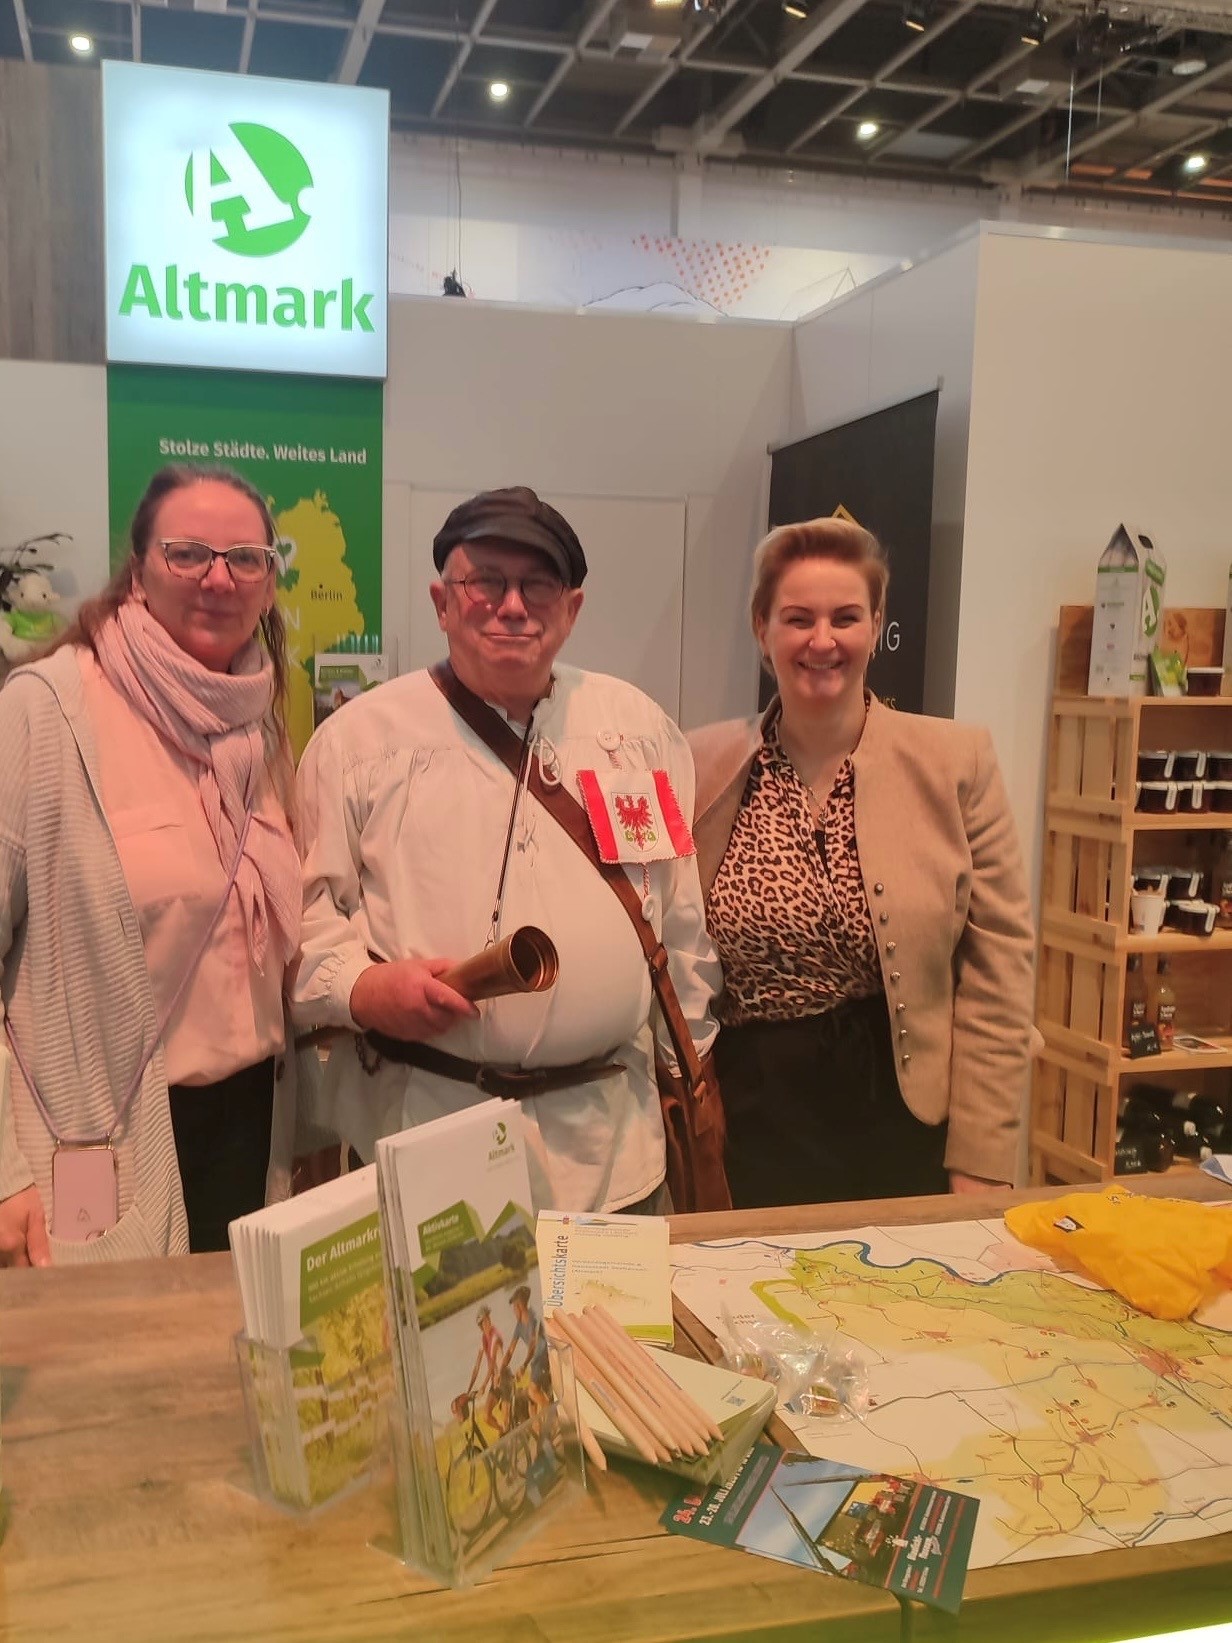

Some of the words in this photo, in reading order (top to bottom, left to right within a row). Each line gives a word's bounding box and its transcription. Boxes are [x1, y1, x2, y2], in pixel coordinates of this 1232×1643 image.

[118, 263, 376, 333] Altmark
[159, 438, 210, 457] Stolze
[213, 440, 270, 460] Städte.
[274, 444, 326, 463] Weites
[330, 448, 367, 465] Land
[311, 589, 343, 601] Berlin
[488, 1143, 515, 1161] Altmark
[306, 1251, 328, 1272] Der
[330, 1227, 381, 1261] Altmarkr
[547, 1235, 569, 1307] Übersichtskarte
